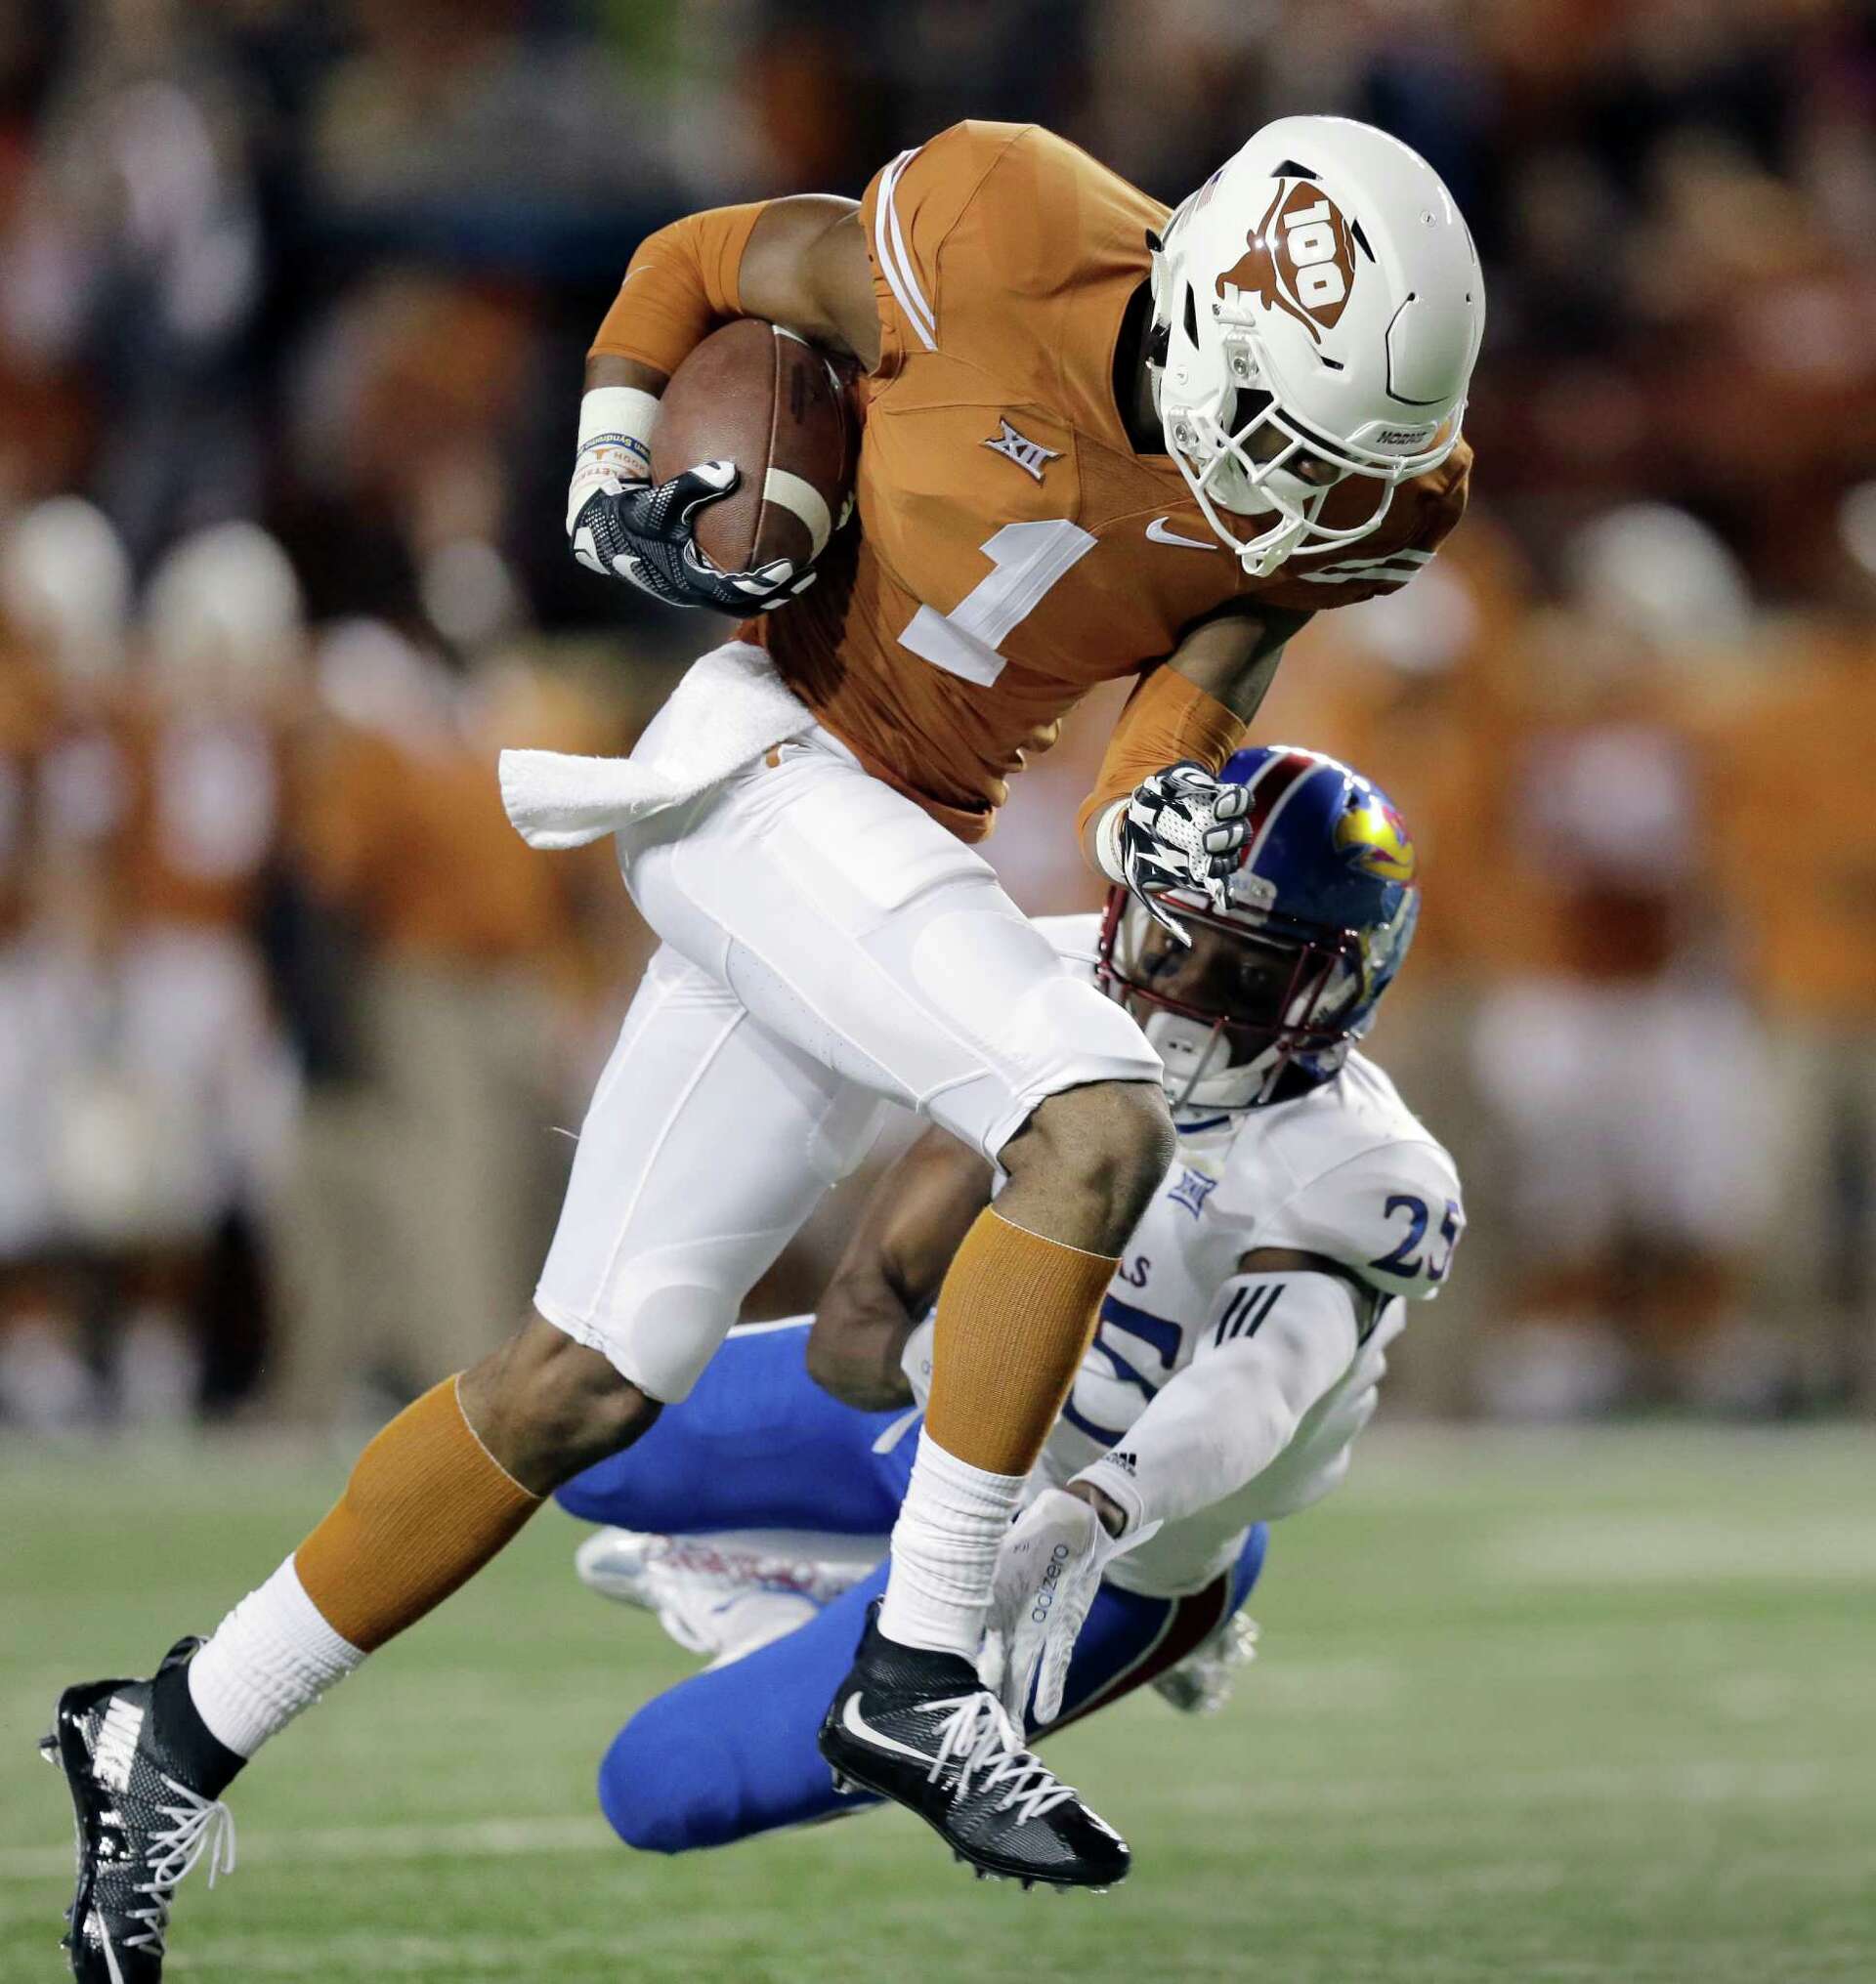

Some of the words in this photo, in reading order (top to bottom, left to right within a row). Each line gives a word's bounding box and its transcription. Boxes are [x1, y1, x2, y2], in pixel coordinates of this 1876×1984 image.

[1283, 198, 1346, 310] 100
[896, 518, 1098, 688] 1
[1367, 1194, 1459, 1282] 25
